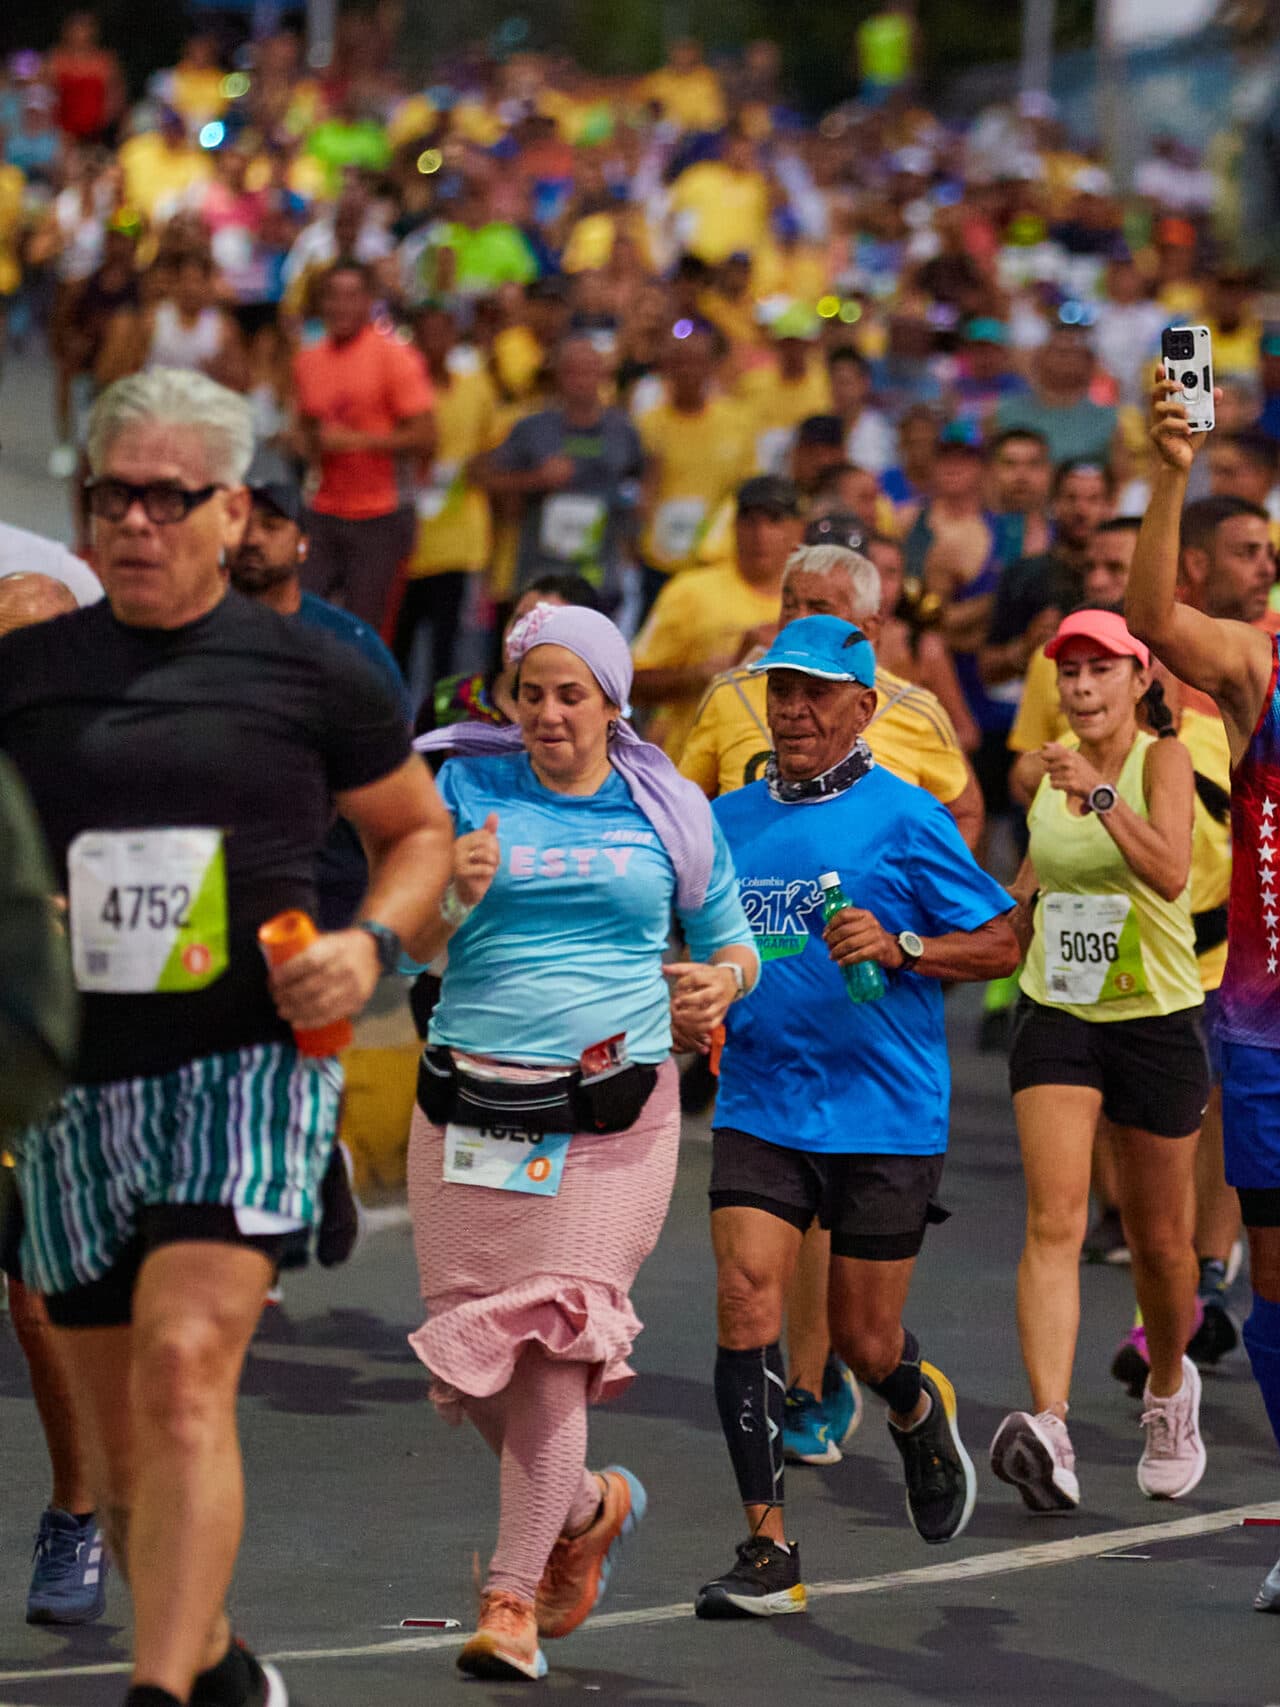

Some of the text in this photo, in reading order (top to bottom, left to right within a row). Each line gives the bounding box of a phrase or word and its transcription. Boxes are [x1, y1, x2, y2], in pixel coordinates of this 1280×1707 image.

[509, 845, 633, 877] ESTY
[741, 876, 784, 887] Columbia
[102, 884, 191, 930] 4752
[740, 889, 809, 934] 21K
[1060, 930, 1119, 963] 5036
